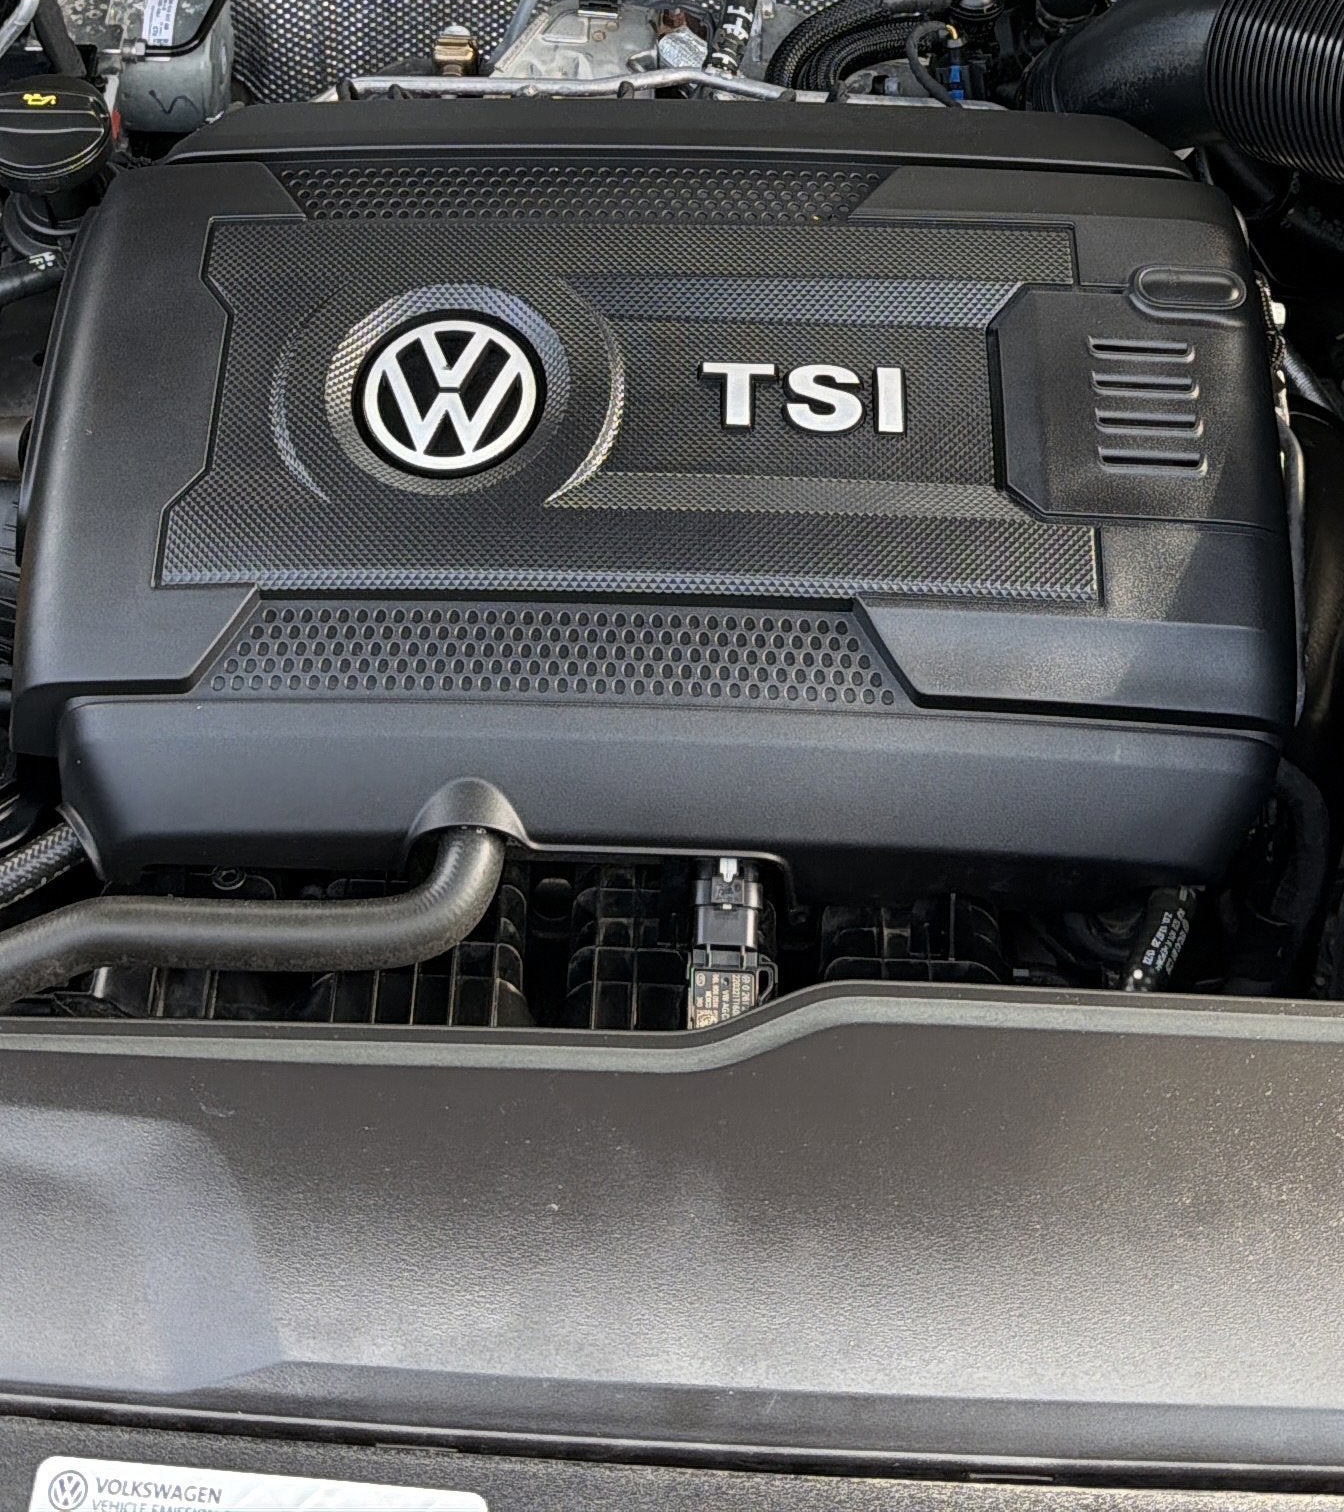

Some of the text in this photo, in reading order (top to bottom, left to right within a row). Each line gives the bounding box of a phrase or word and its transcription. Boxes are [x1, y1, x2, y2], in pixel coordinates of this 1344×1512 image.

[702, 361, 905, 434] TSI
[95, 1476, 223, 1504] VOLKSWAGEN
[92, 1498, 147, 1512] VEHICLE
